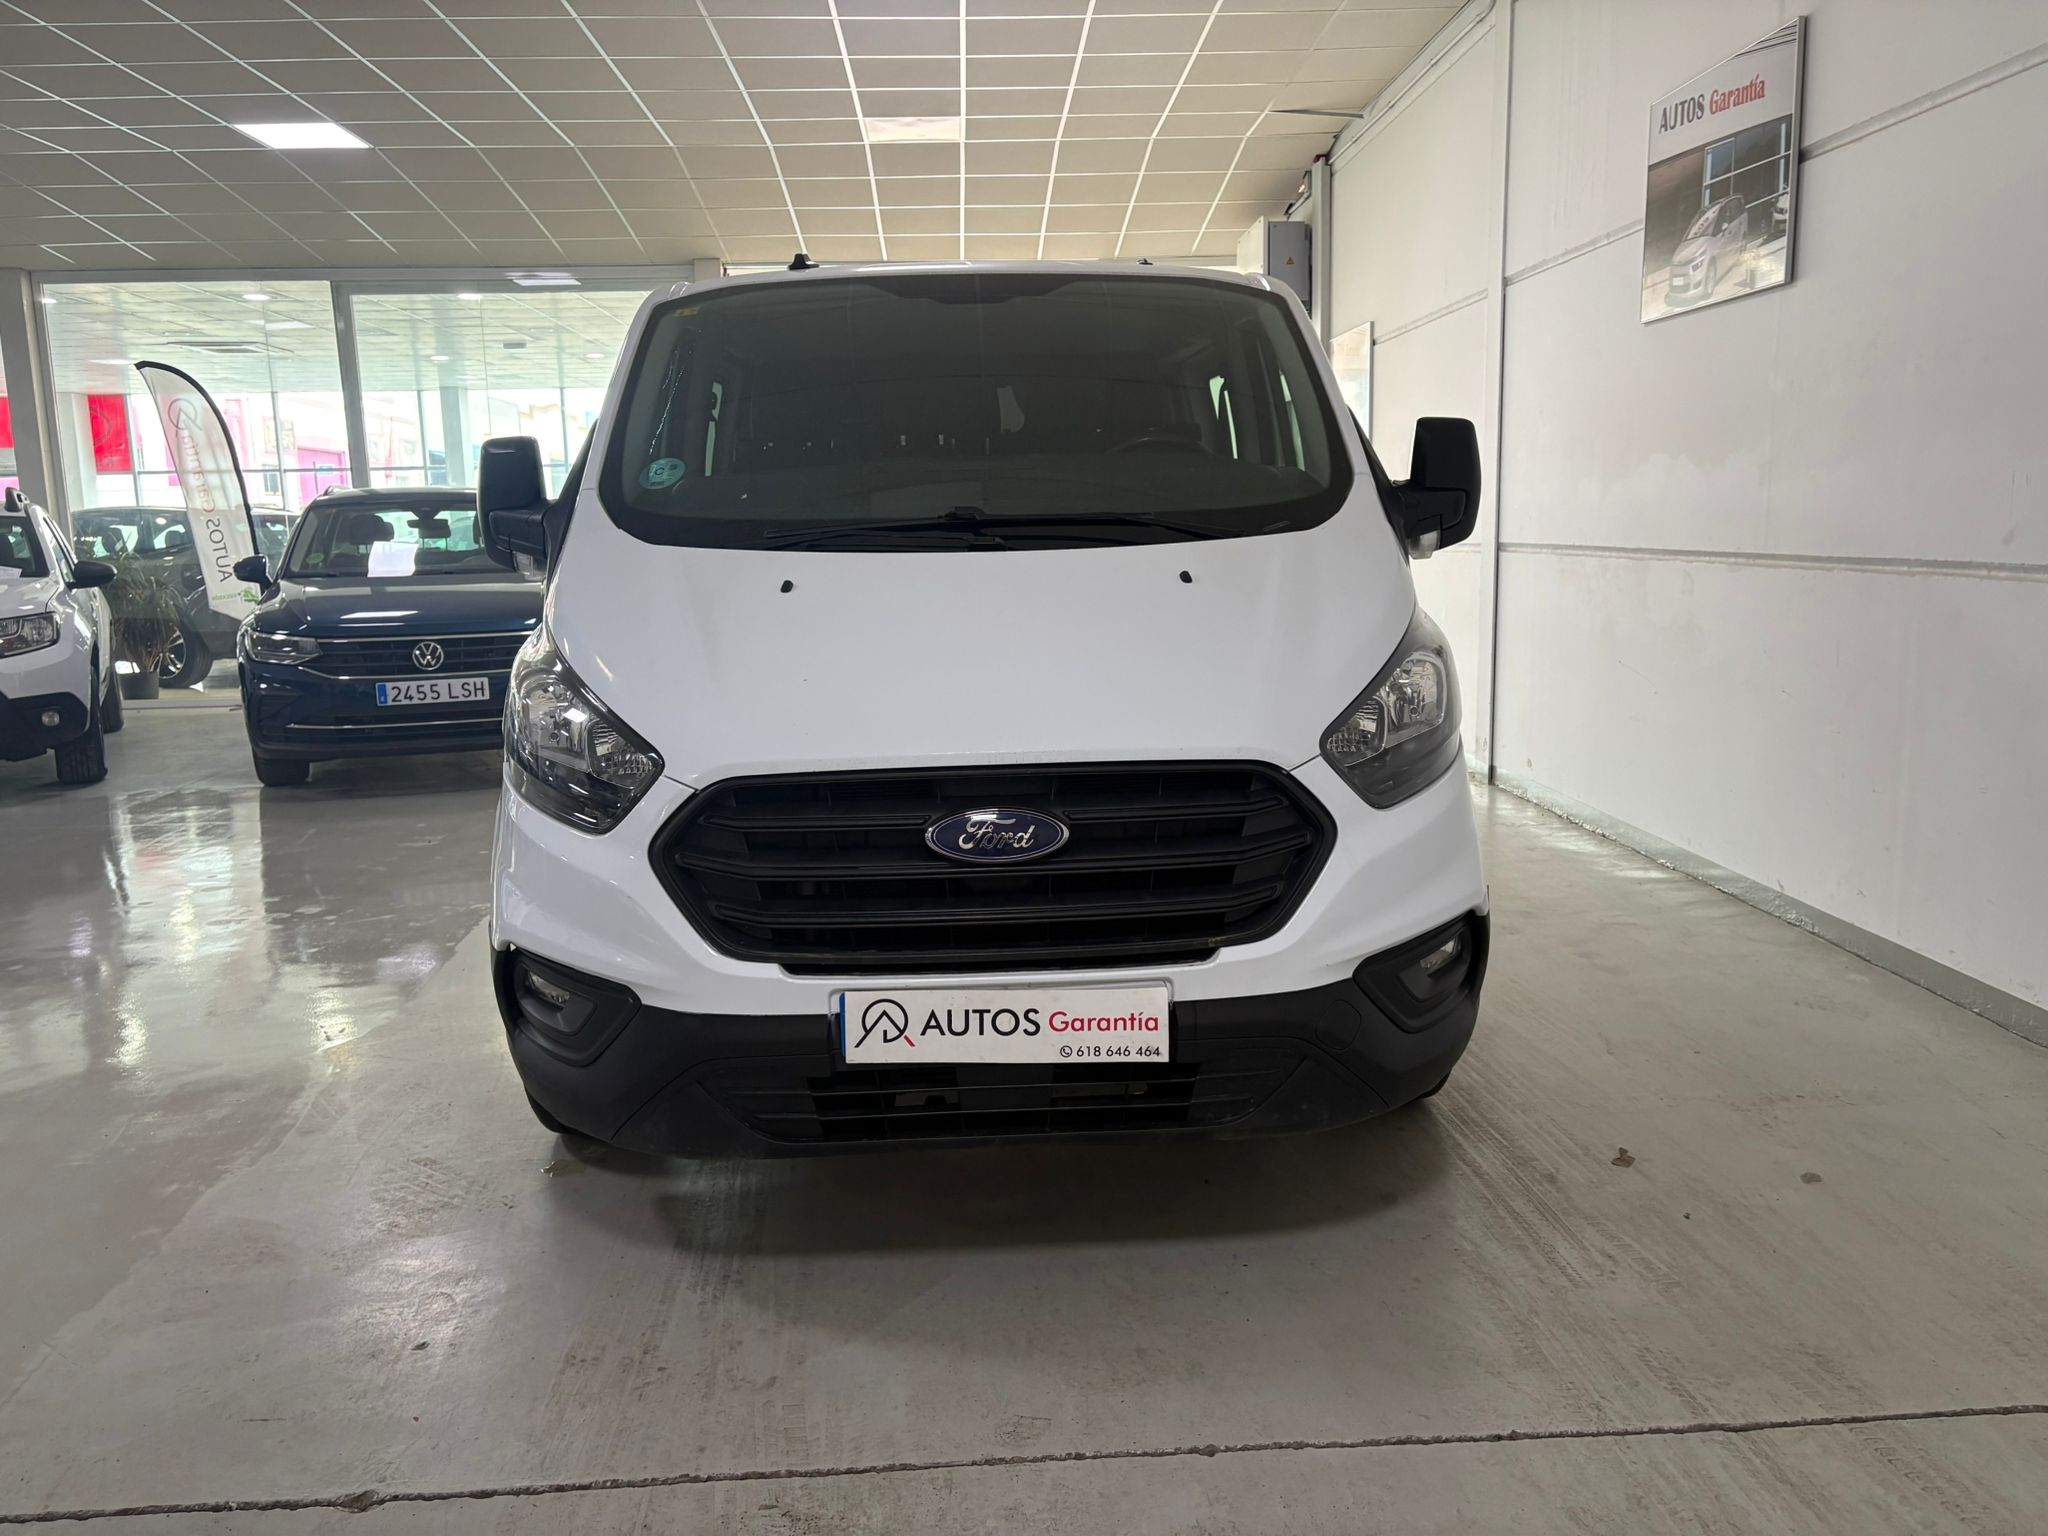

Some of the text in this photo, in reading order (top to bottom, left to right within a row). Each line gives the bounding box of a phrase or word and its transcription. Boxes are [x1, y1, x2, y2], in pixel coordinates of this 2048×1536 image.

[1659, 74, 1765, 134] AUTOS Garantía
[391, 681, 485, 703] 2455 LSH
[958, 815, 1036, 850] Ford
[920, 1008, 1159, 1037] AUTOS Garantía
[1076, 1045, 1161, 1057] 618 646 464
